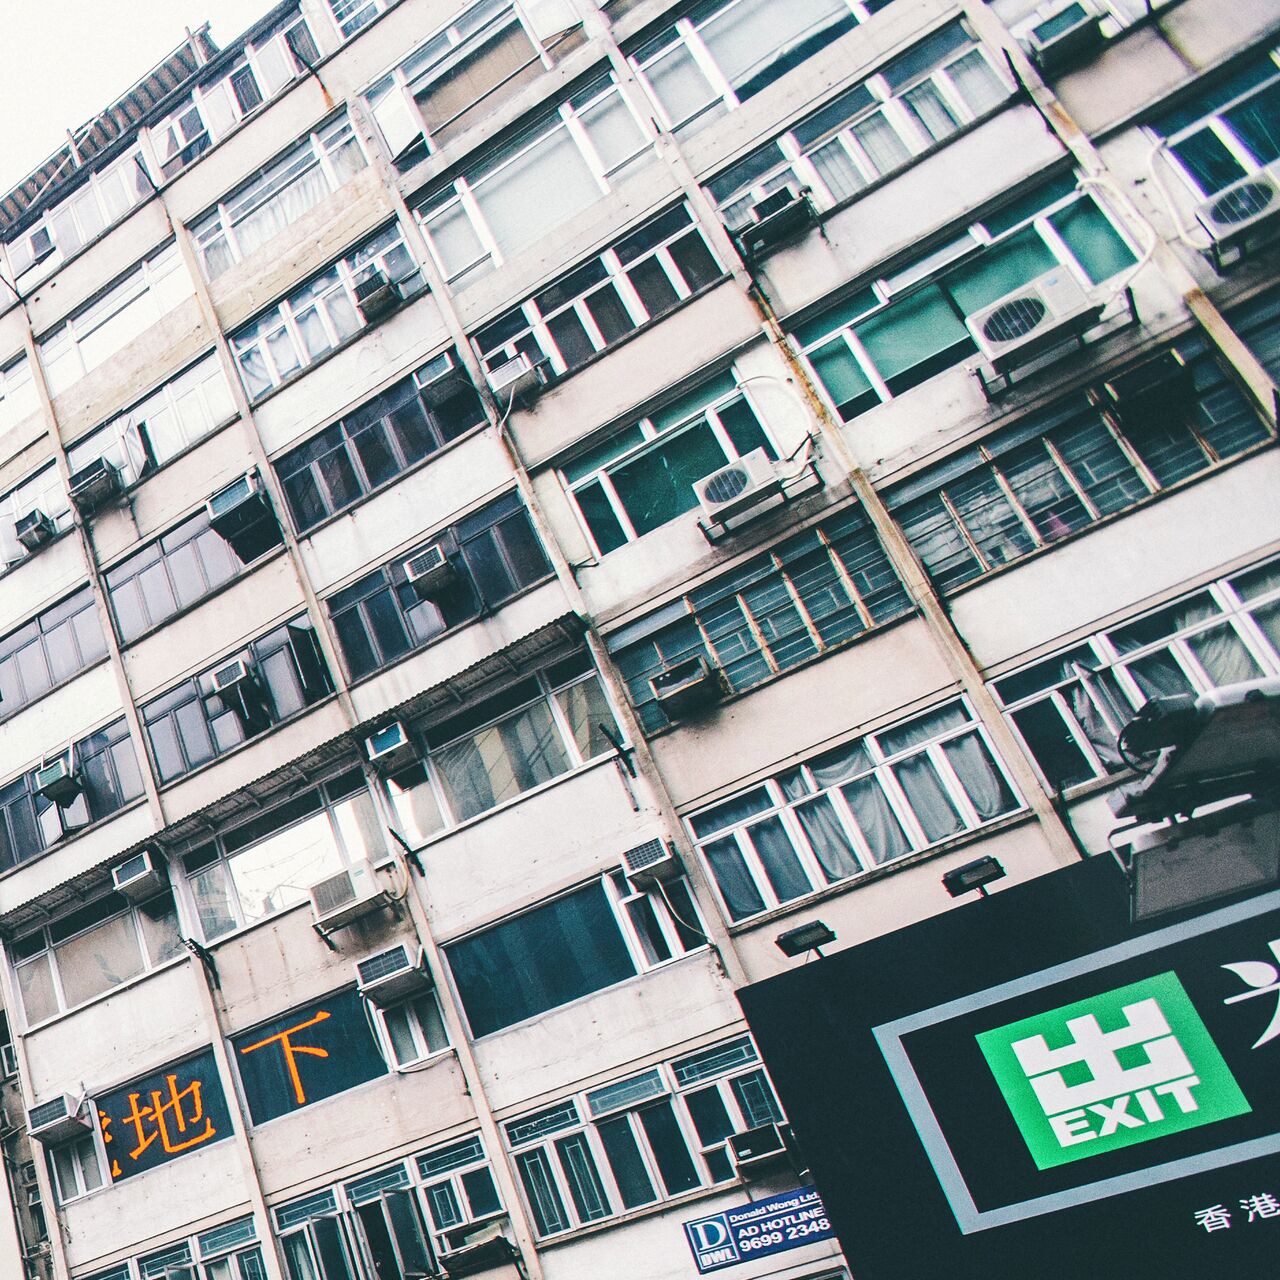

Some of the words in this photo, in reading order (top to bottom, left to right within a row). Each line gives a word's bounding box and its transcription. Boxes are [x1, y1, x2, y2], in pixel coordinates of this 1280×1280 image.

[1010, 996, 1196, 1116] 出
[1047, 1074, 1202, 1150] EXIT
[728, 1205, 767, 1223] Donald
[766, 1198, 800, 1217] Wong
[799, 1191, 821, 1207] Ltd.
[737, 1225, 760, 1239] AD
[760, 1206, 826, 1234] HOTLINE
[692, 1219, 727, 1252] D
[739, 1231, 784, 1253] 9699
[786, 1218, 832, 1242] 2348
[700, 1247, 736, 1268] DWL
